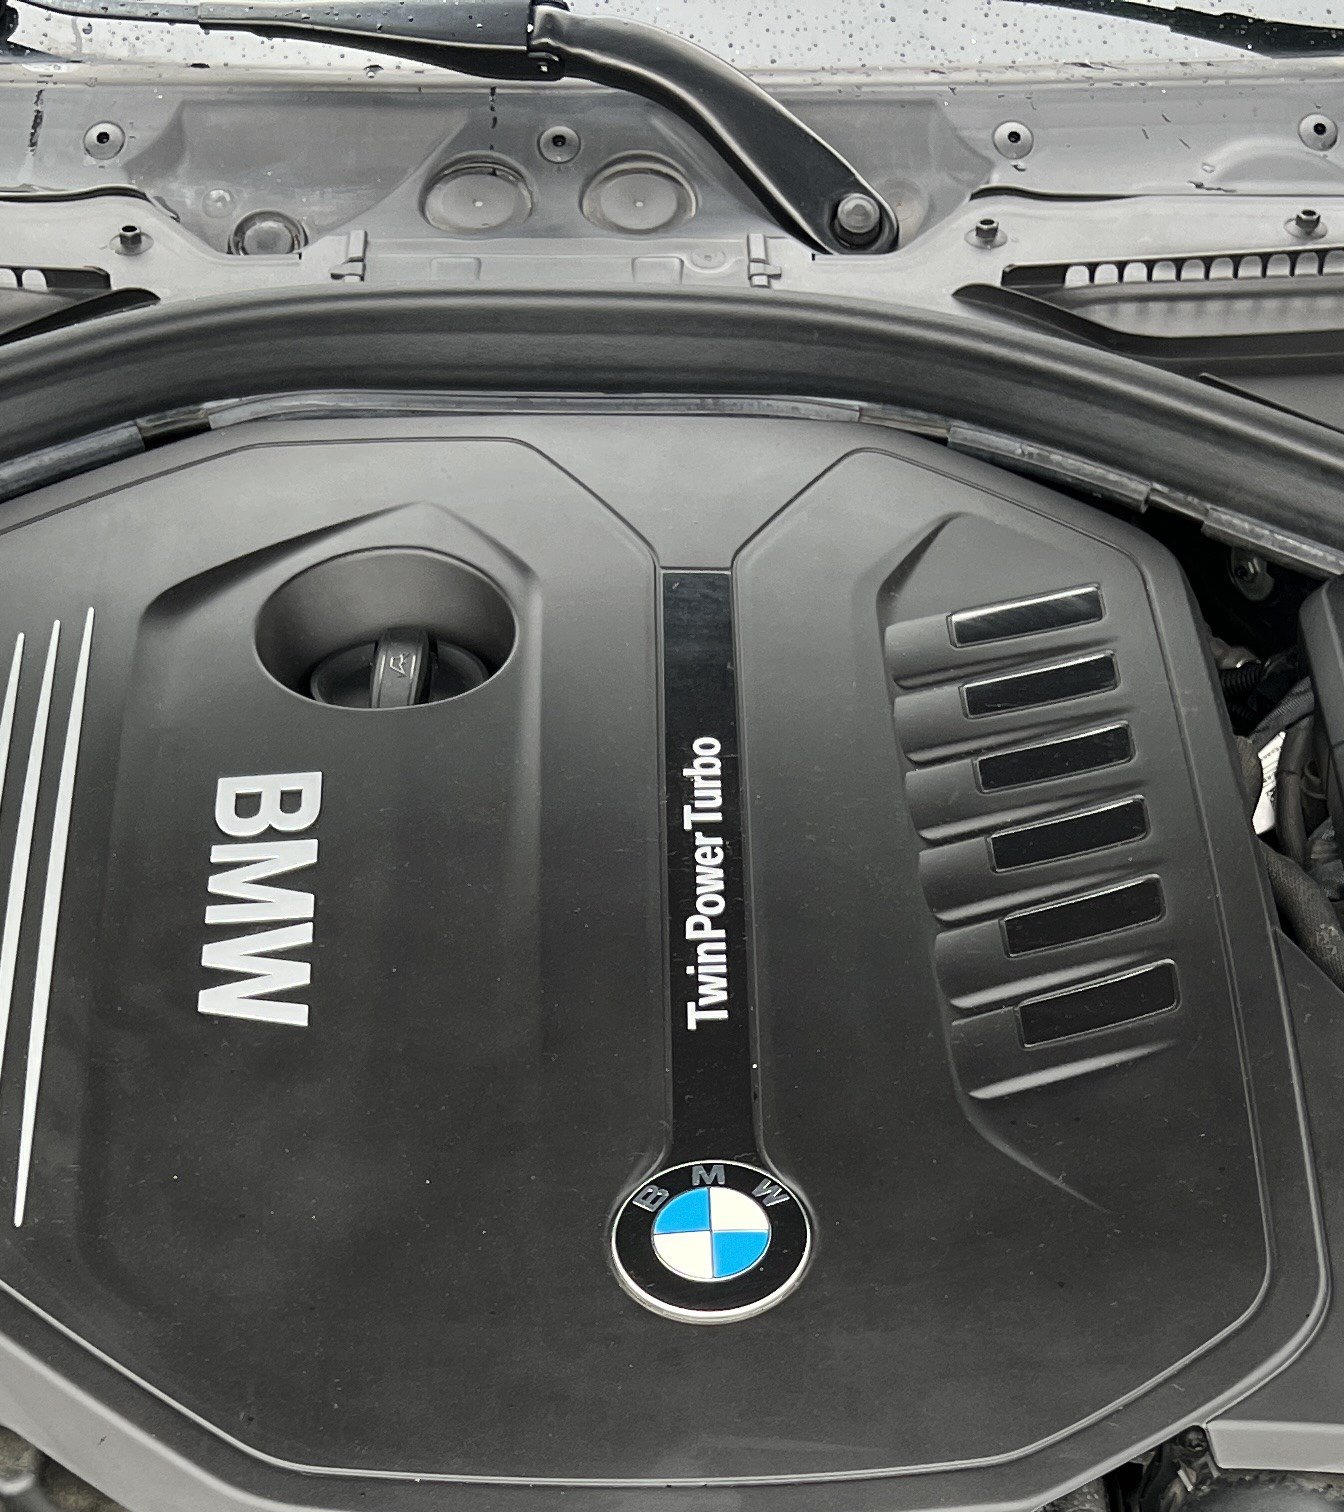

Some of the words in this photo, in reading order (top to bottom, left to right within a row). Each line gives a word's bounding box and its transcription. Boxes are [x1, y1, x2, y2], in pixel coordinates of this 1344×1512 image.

[683, 736, 723, 831] Turbo
[198, 771, 323, 1027] BMW
[684, 831, 729, 1031] TwinPower
[632, 1164, 790, 1213] BMW
